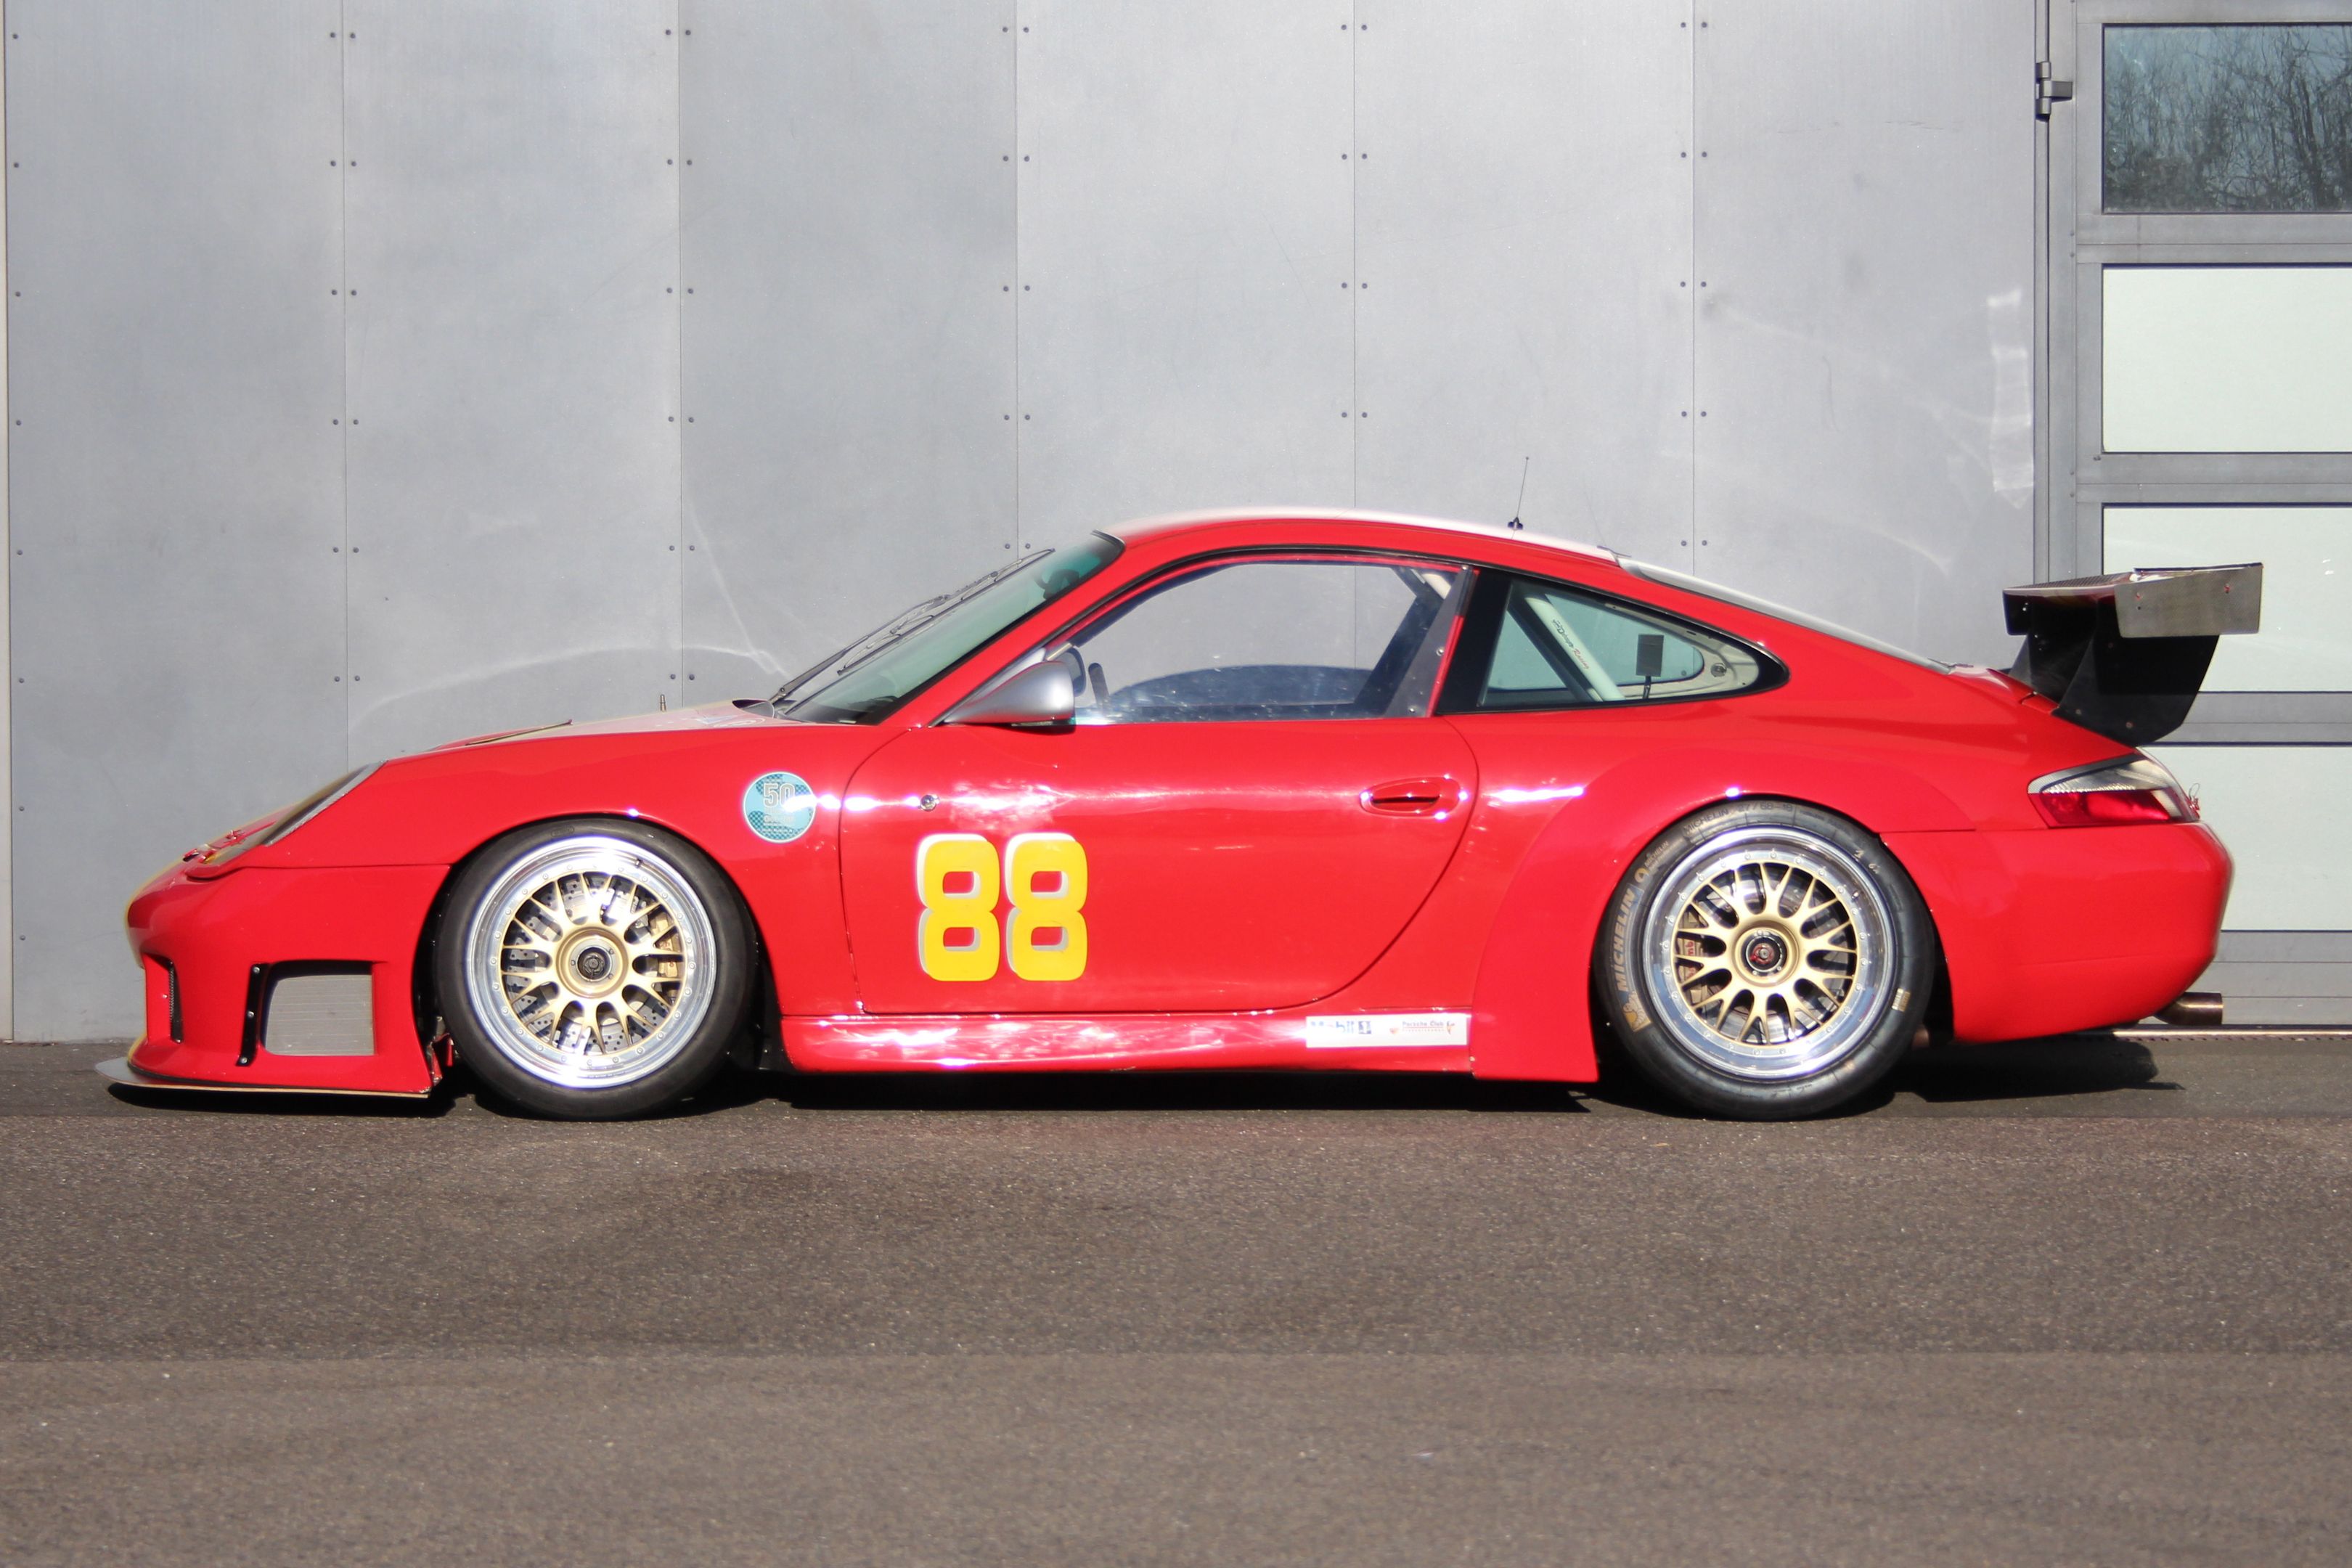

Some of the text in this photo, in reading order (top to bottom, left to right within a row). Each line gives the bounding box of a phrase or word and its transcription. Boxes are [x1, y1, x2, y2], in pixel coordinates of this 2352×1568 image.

[764, 783, 795, 807] 50
[1683, 809, 1729, 834] MICHELIN
[916, 833, 1087, 981] 88
[1613, 888, 1635, 992] MICHELIN
